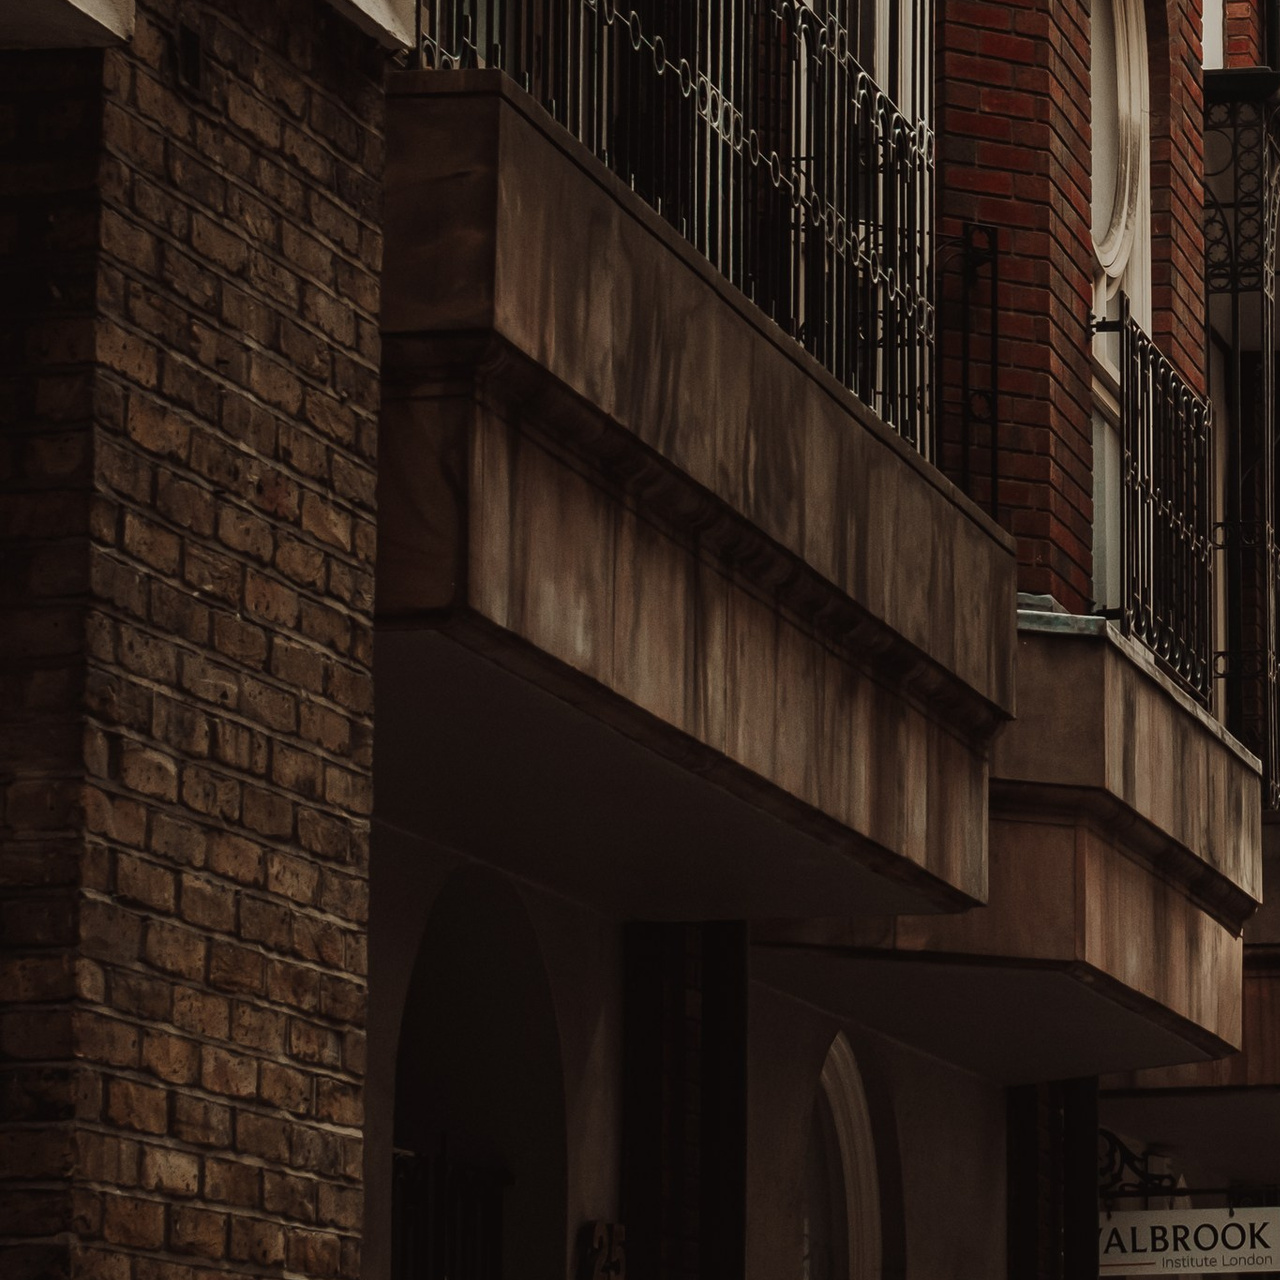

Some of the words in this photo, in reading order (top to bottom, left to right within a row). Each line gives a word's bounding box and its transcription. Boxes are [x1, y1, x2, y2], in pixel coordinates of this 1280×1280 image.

[1100, 1222, 1271, 1254] ALBROOK
[1162, 1256, 1217, 1269] Institute
[1222, 1253, 1273, 1267] London
